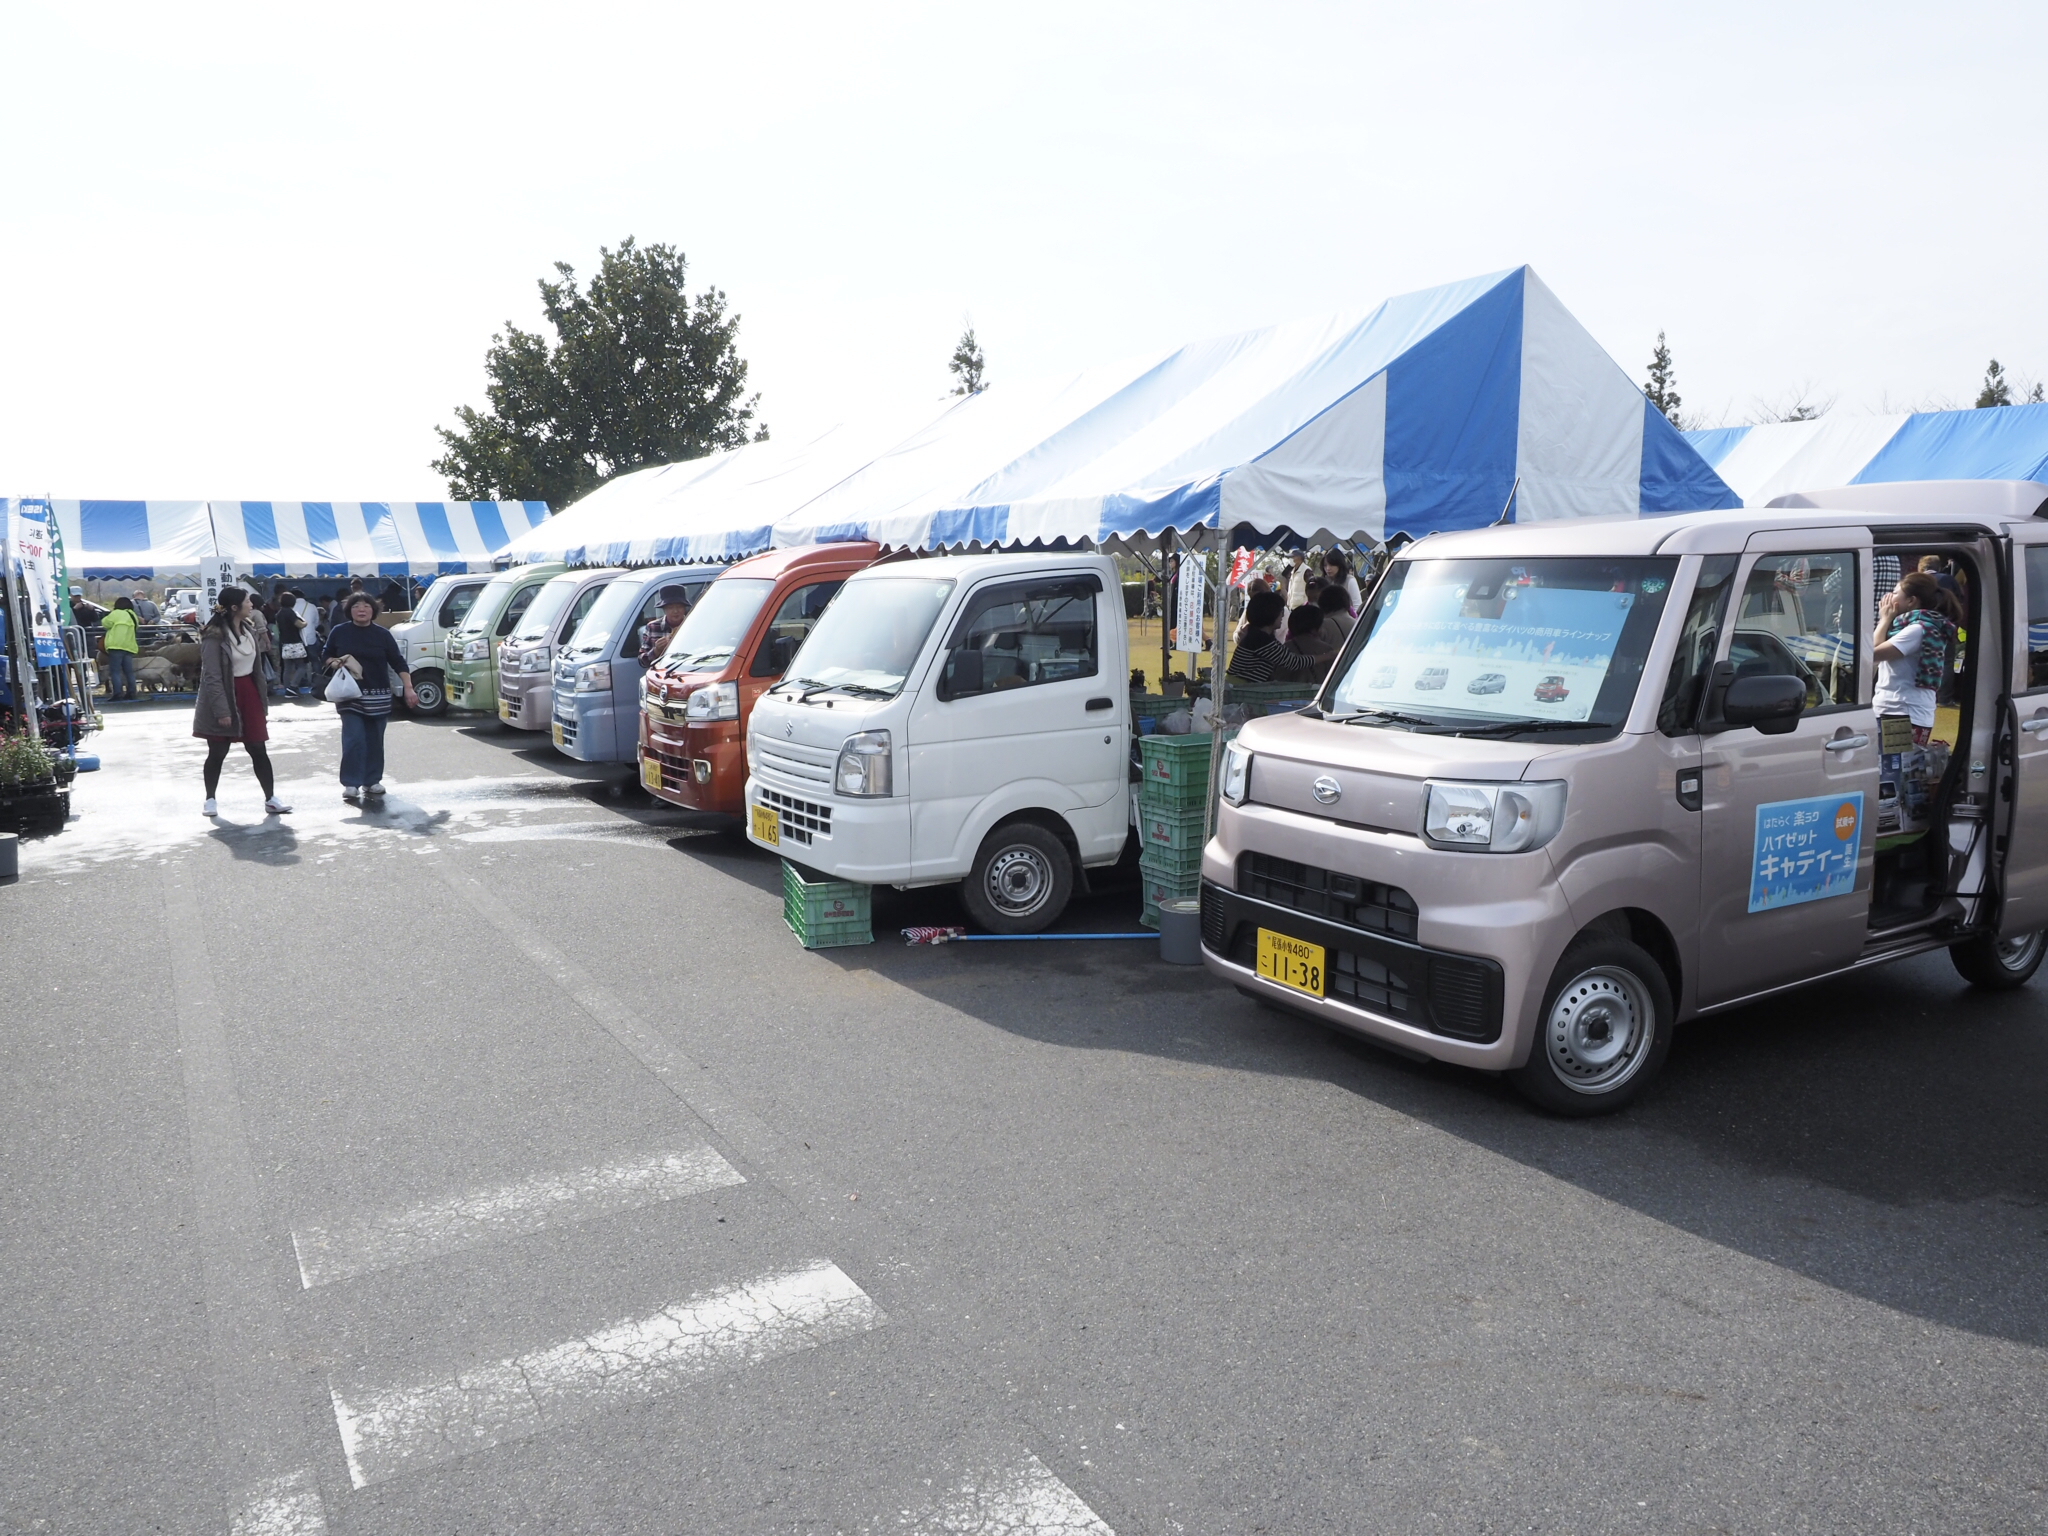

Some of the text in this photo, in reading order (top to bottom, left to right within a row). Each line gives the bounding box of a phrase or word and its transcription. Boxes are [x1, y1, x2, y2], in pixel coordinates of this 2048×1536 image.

[1763, 816, 1790, 829] はたらく
[1762, 830, 1818, 852] ハイゼット
[1760, 850, 1844, 881] キャディー
[1261, 953, 1320, 991] こ 11-38
